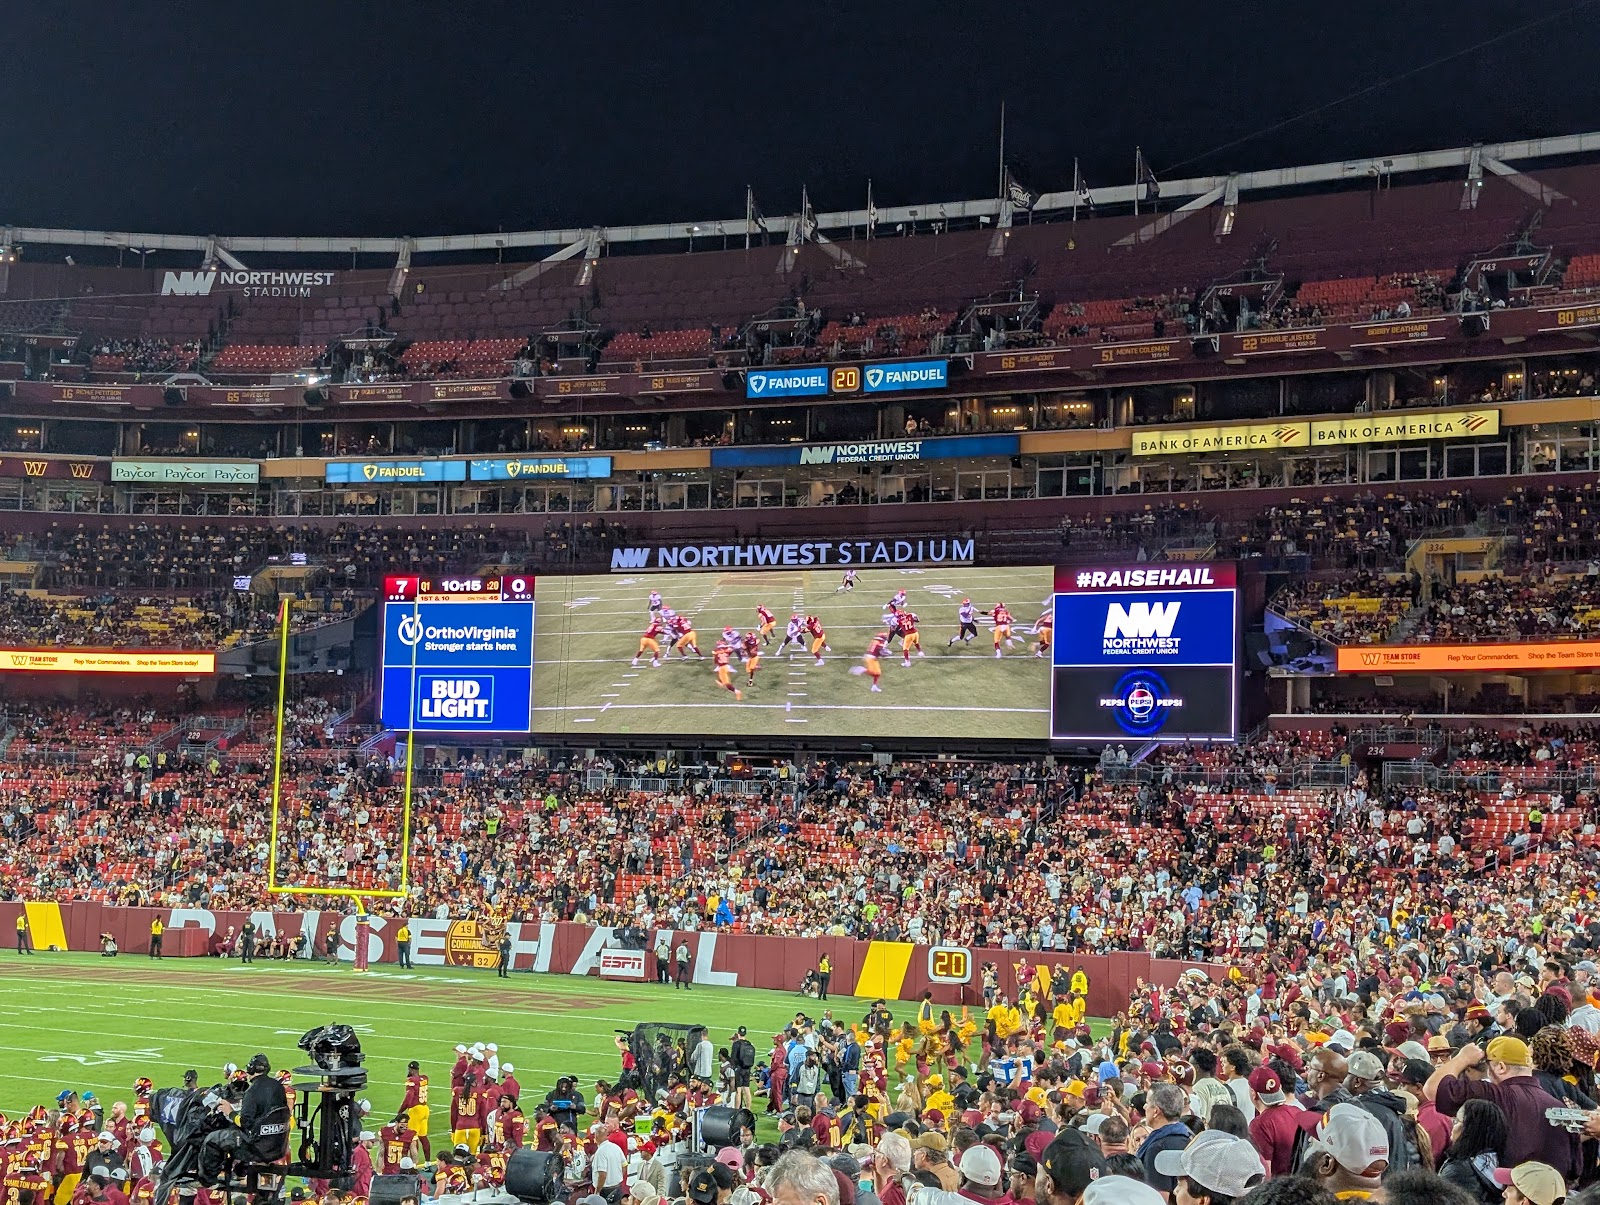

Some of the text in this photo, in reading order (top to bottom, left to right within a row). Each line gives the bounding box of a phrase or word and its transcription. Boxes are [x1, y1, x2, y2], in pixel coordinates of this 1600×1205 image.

[161, 271, 217, 296] NW
[221, 272, 335, 286] NORTHWEST
[243, 287, 311, 297] STADIUM
[1558, 311, 1575, 324] 80
[1243, 338, 1258, 350] 22
[1101, 350, 1114, 361] 51
[1001, 357, 1016, 368] 66
[836, 372, 856, 387] 20
[886, 369, 945, 383] FANDUEL
[558, 382, 571, 392] 53
[769, 377, 825, 389] FANDUEL
[62, 389, 73, 399] 16
[227, 392, 240, 402] 65
[349, 389, 360, 399] 17
[1318, 422, 1454, 440] BANK OF AMERICA
[836, 441, 922, 456] NORTHWEST
[1140, 434, 1267, 451] BANK OF AMERICA
[800, 445, 836, 465] NW
[836, 452, 920, 463] FEDERAL CREDIT UNION
[116, 468, 158, 480] Paycor
[165, 469, 207, 480] Paycor
[379, 466, 425, 477] FANDUEL
[522, 462, 569, 475] FANDUEL
[214, 470, 256, 481] Paycor
[611, 539, 975, 568] NW NORTHWEST STADIUM
[1076, 567, 1215, 588] #RAISEHAIL
[395, 580, 408, 594] 7
[420, 581, 430, 591] Q1
[441, 580, 481, 592] 10:15
[511, 578, 526, 593] 0
[1103, 601, 1182, 639] NW
[425, 626, 517, 641] OrthoVirginia
[424, 642, 464, 653] Stronger
[466, 642, 493, 651] starts
[1103, 638, 1181, 649] NORTHWEST
[1401, 652, 1421, 660] STORE
[1528, 652, 1545, 660] Shop
[431, 680, 480, 699] BUD
[421, 699, 488, 718] LIGHT
[1100, 699, 1126, 707] PEPSI
[1156, 699, 1182, 707] PEPSI
[1367, 746, 1385, 756] 234
[460, 925, 472, 934] 19
[1130, 927, 1140, 938] 21
[477, 957, 489, 966] 32
[602, 956, 642, 970] ESPN
[935, 952, 966, 977] 20
[457, 1097, 477, 1117] 50
[828, 1125, 841, 1148] 10
